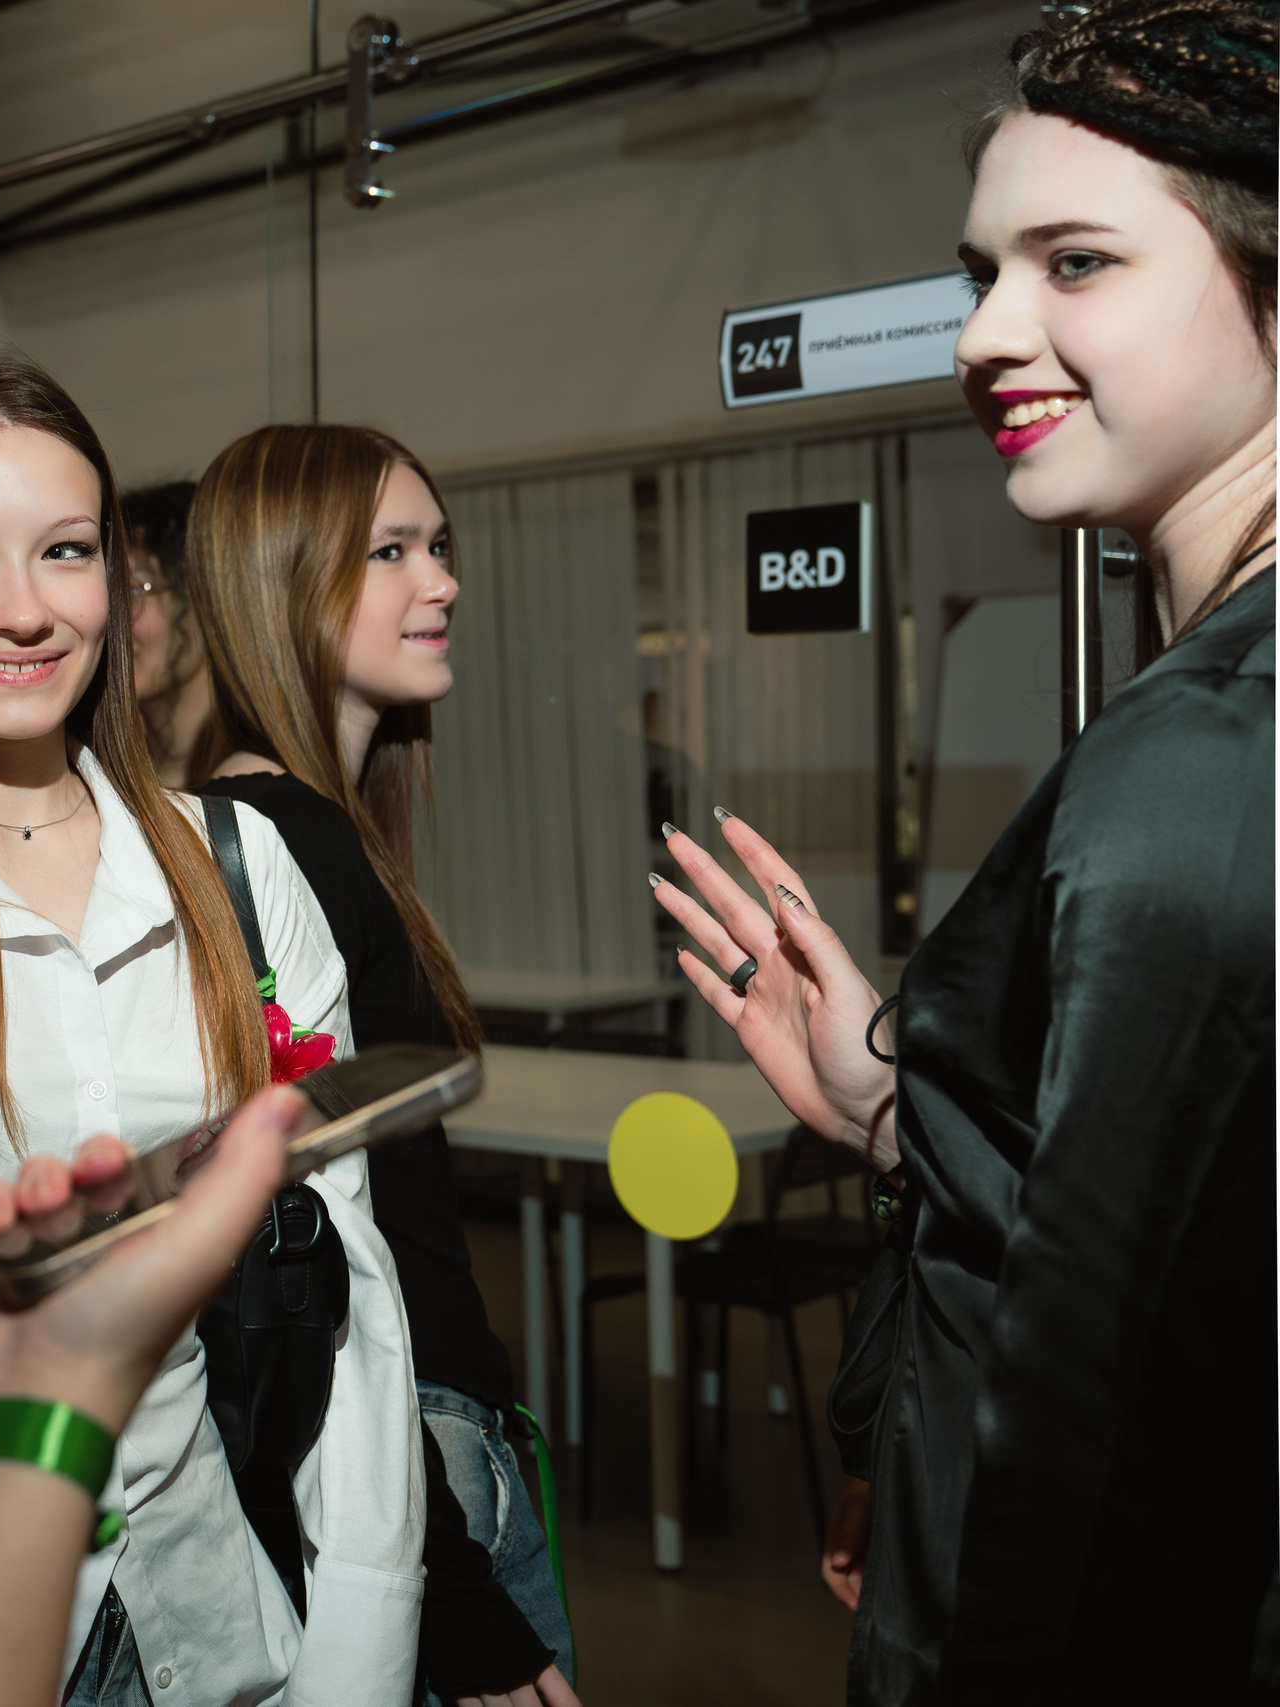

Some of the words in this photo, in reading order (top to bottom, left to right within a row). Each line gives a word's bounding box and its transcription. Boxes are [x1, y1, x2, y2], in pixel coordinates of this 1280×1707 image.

[736, 335, 793, 374] 247
[808, 330, 883, 354] ПРИЁМНАЯ
[885, 317, 963, 342] КОМИССИЯ
[759, 546, 846, 592] B&D
